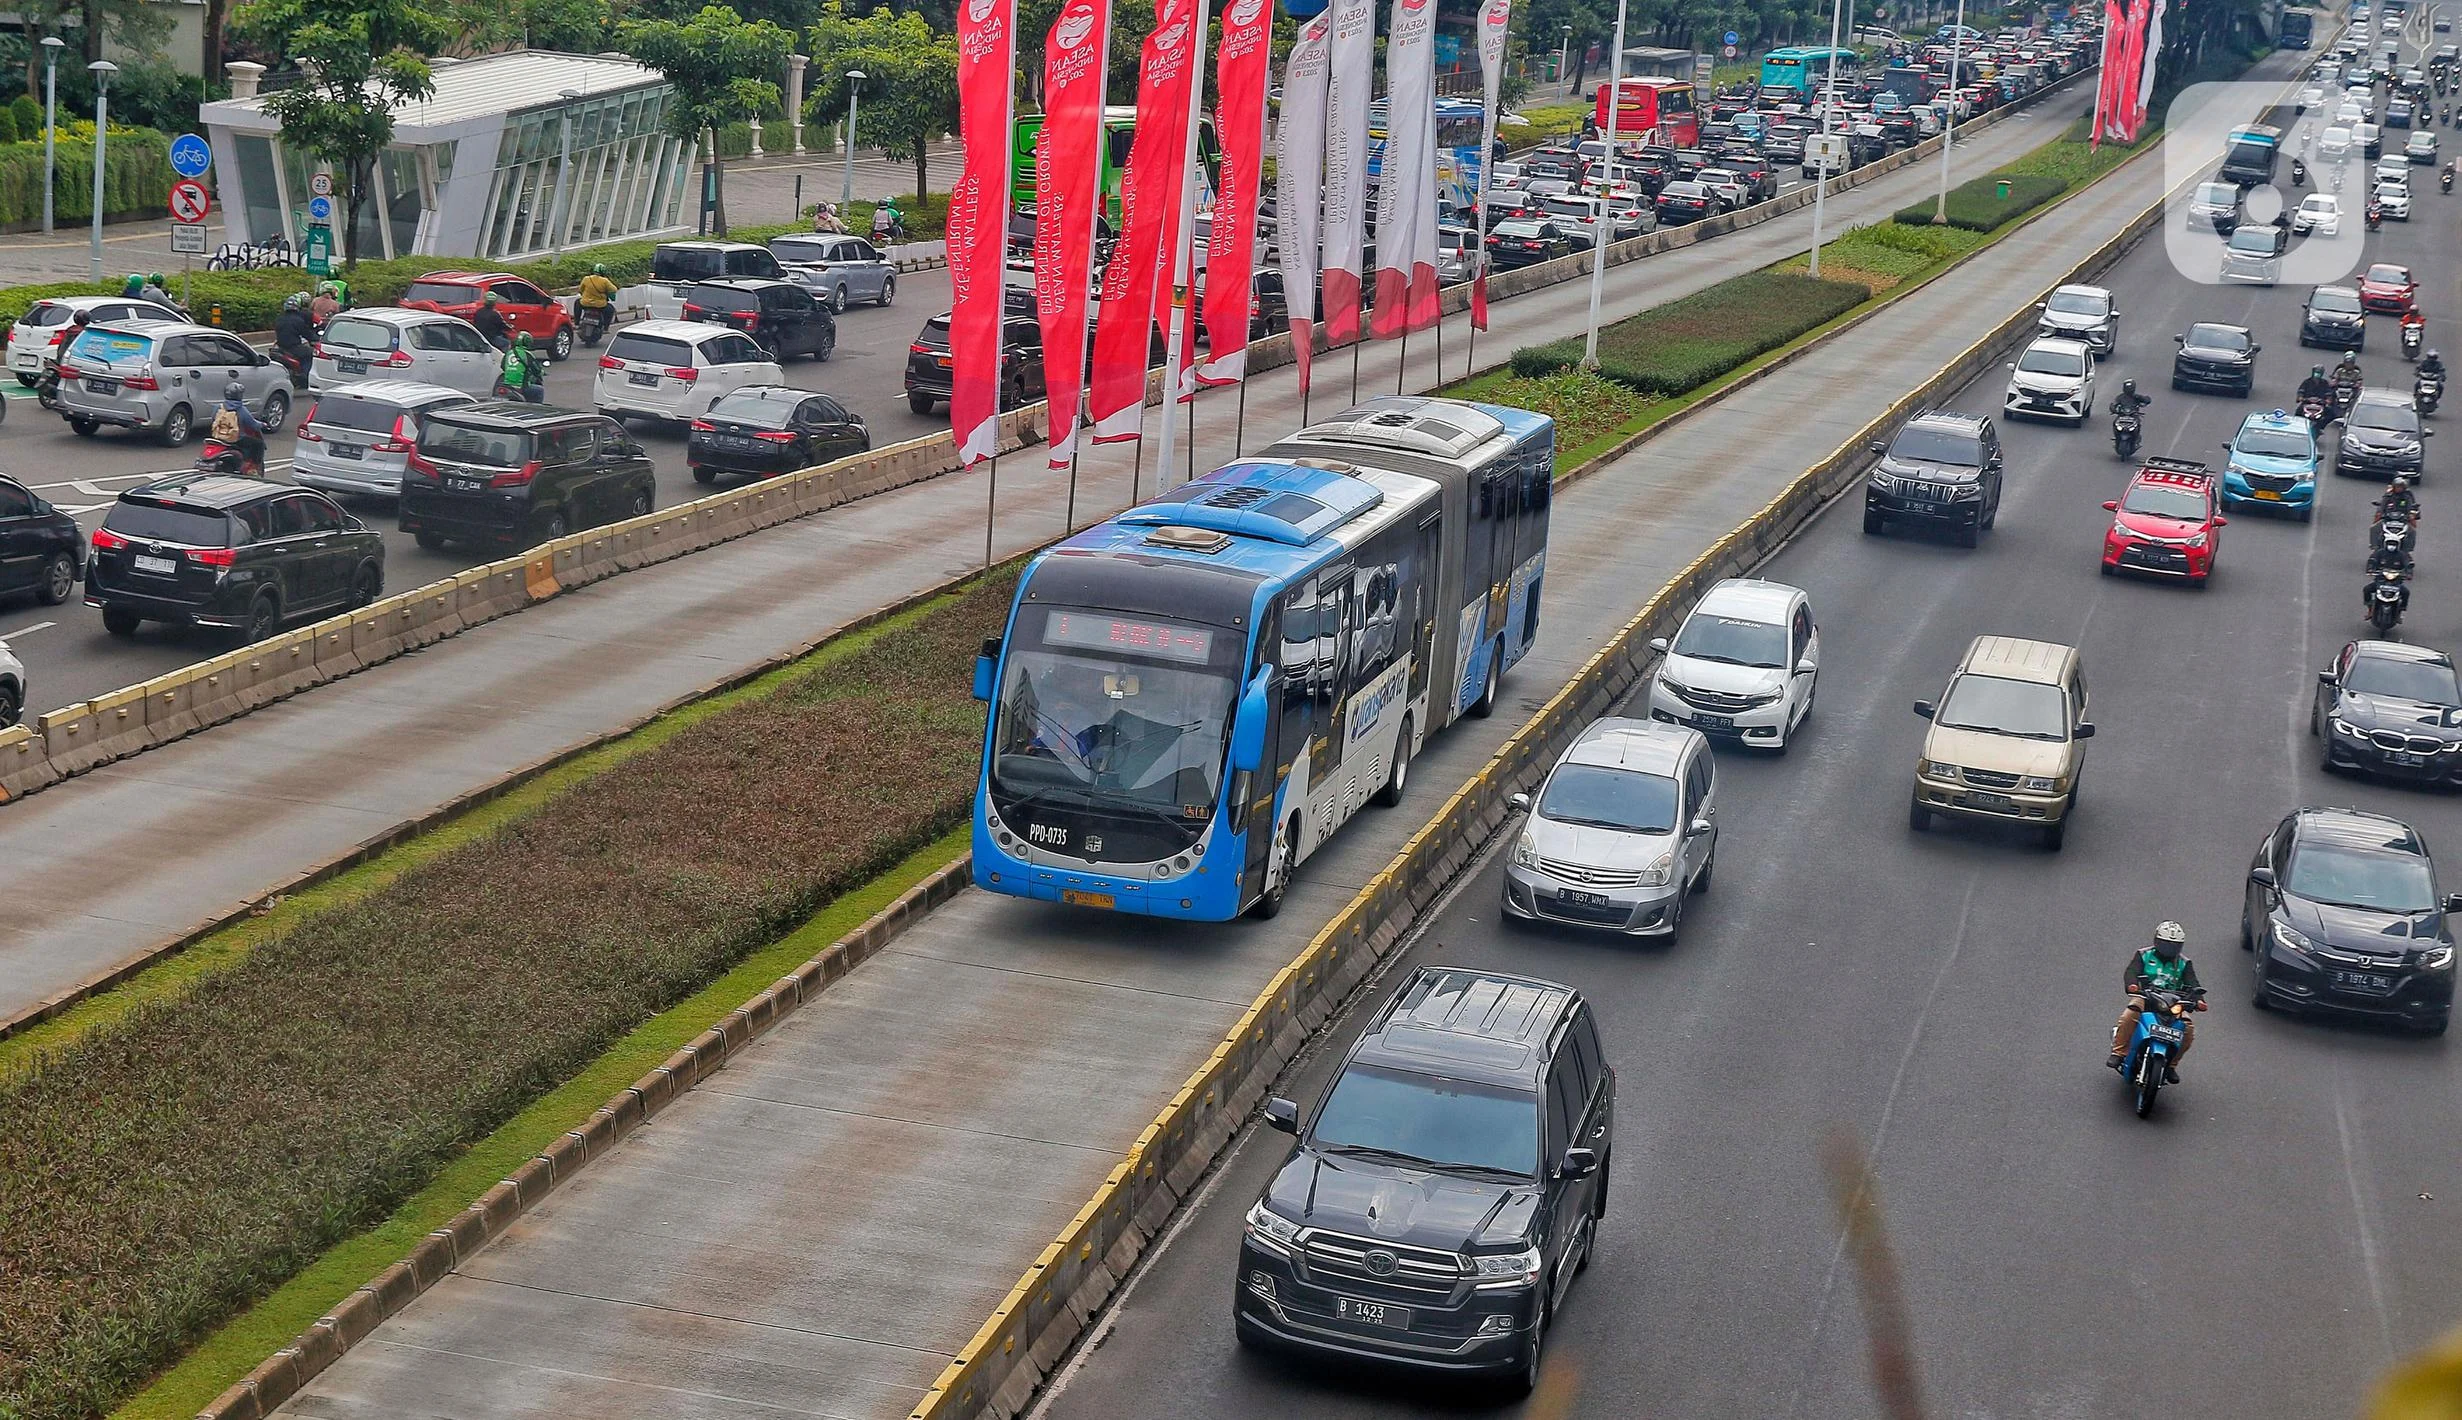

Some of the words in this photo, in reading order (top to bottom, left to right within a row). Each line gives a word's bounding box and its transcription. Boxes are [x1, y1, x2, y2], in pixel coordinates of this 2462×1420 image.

[315, 179, 326, 188] 25
[457, 479, 466, 487] 77
[1728, 618, 1762, 628] DAIKIN
[1692, 714, 1698, 722] B
[1029, 823, 1068, 846] PPD-0735
[1559, 890, 1566, 899] B
[1571, 892, 1589, 903] 1957
[2337, 972, 2344, 982] B
[2349, 974, 2368, 984] 1974
[1339, 1300, 1347, 1312] B
[1355, 1303, 1385, 1318] 1423
